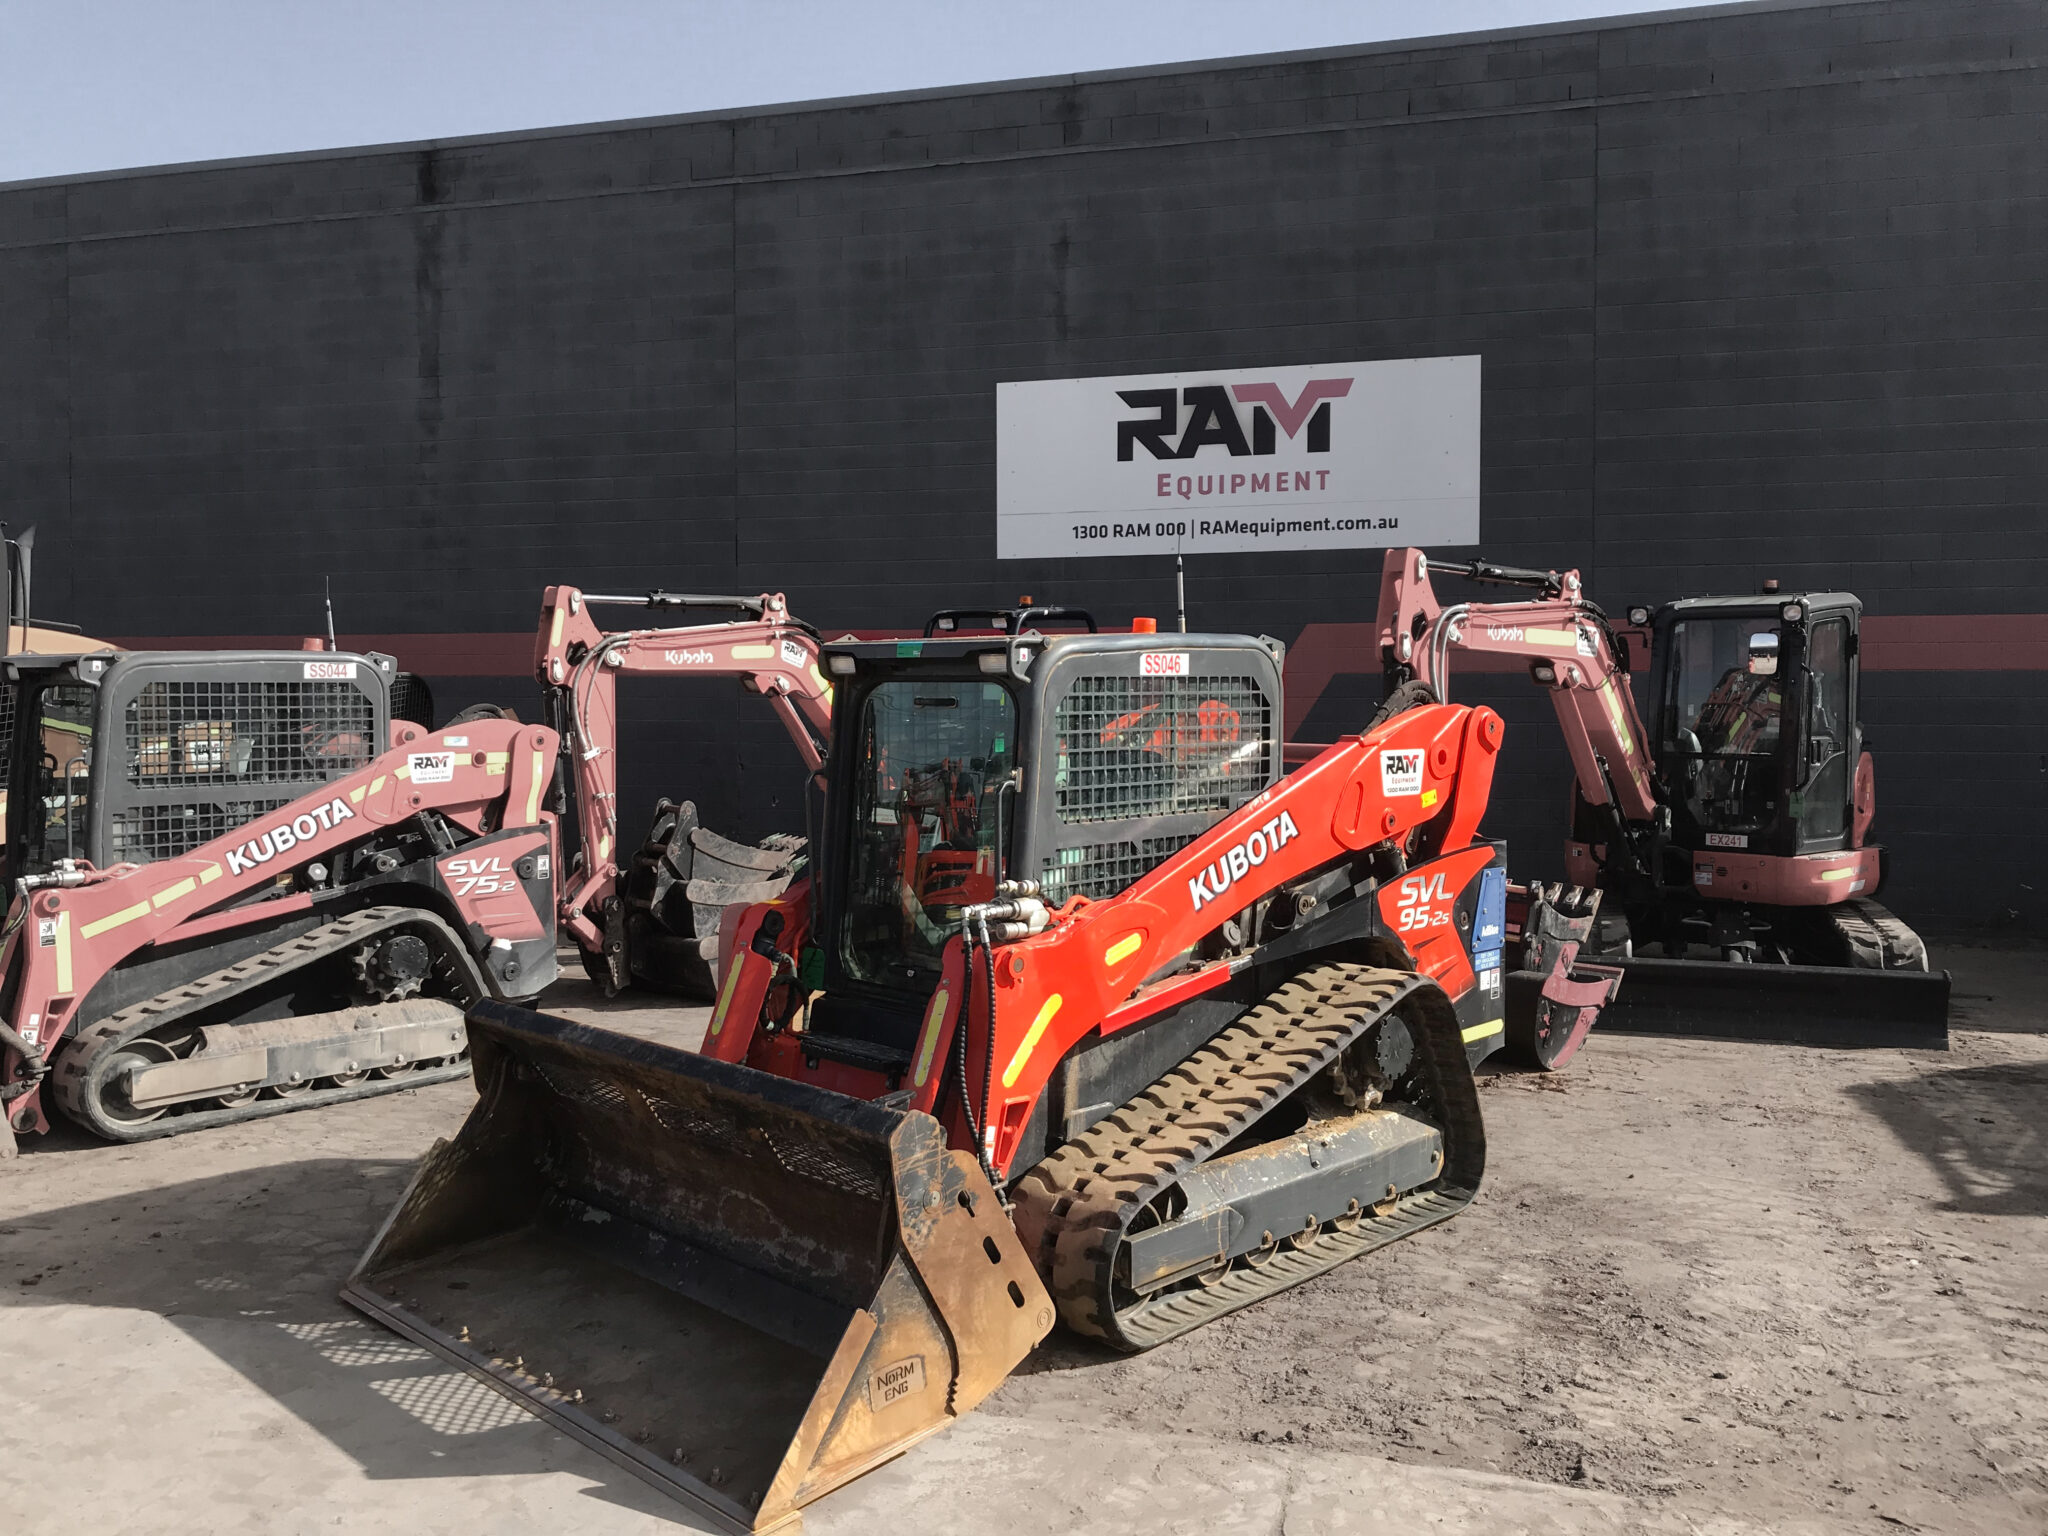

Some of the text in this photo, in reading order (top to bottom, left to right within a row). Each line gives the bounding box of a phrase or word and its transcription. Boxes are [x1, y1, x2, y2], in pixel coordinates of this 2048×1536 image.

[1115, 378, 1355, 462] RAM
[1157, 470, 1331, 500] EQUIPMENT
[1072, 517, 1399, 539] 1300 RAM 000 RAMequipment.com.au
[1487, 623, 1524, 642] Kubota
[665, 649, 714, 665] Kubota
[784, 642, 808, 658] RAM
[309, 663, 347, 678] SS044
[1145, 654, 1181, 674] SS046
[414, 755, 450, 769] RAM
[1386, 755, 1420, 775] RAM
[225, 797, 356, 876] KUBOTA
[1710, 834, 1742, 846] EX241
[445, 856, 511, 877] SVL
[1188, 809, 1300, 912] KUBOTA
[455, 875, 516, 896] 75-2
[1397, 872, 1454, 907] SVL
[877, 1362, 914, 1390] NORM
[884, 1380, 908, 1402] ENG
